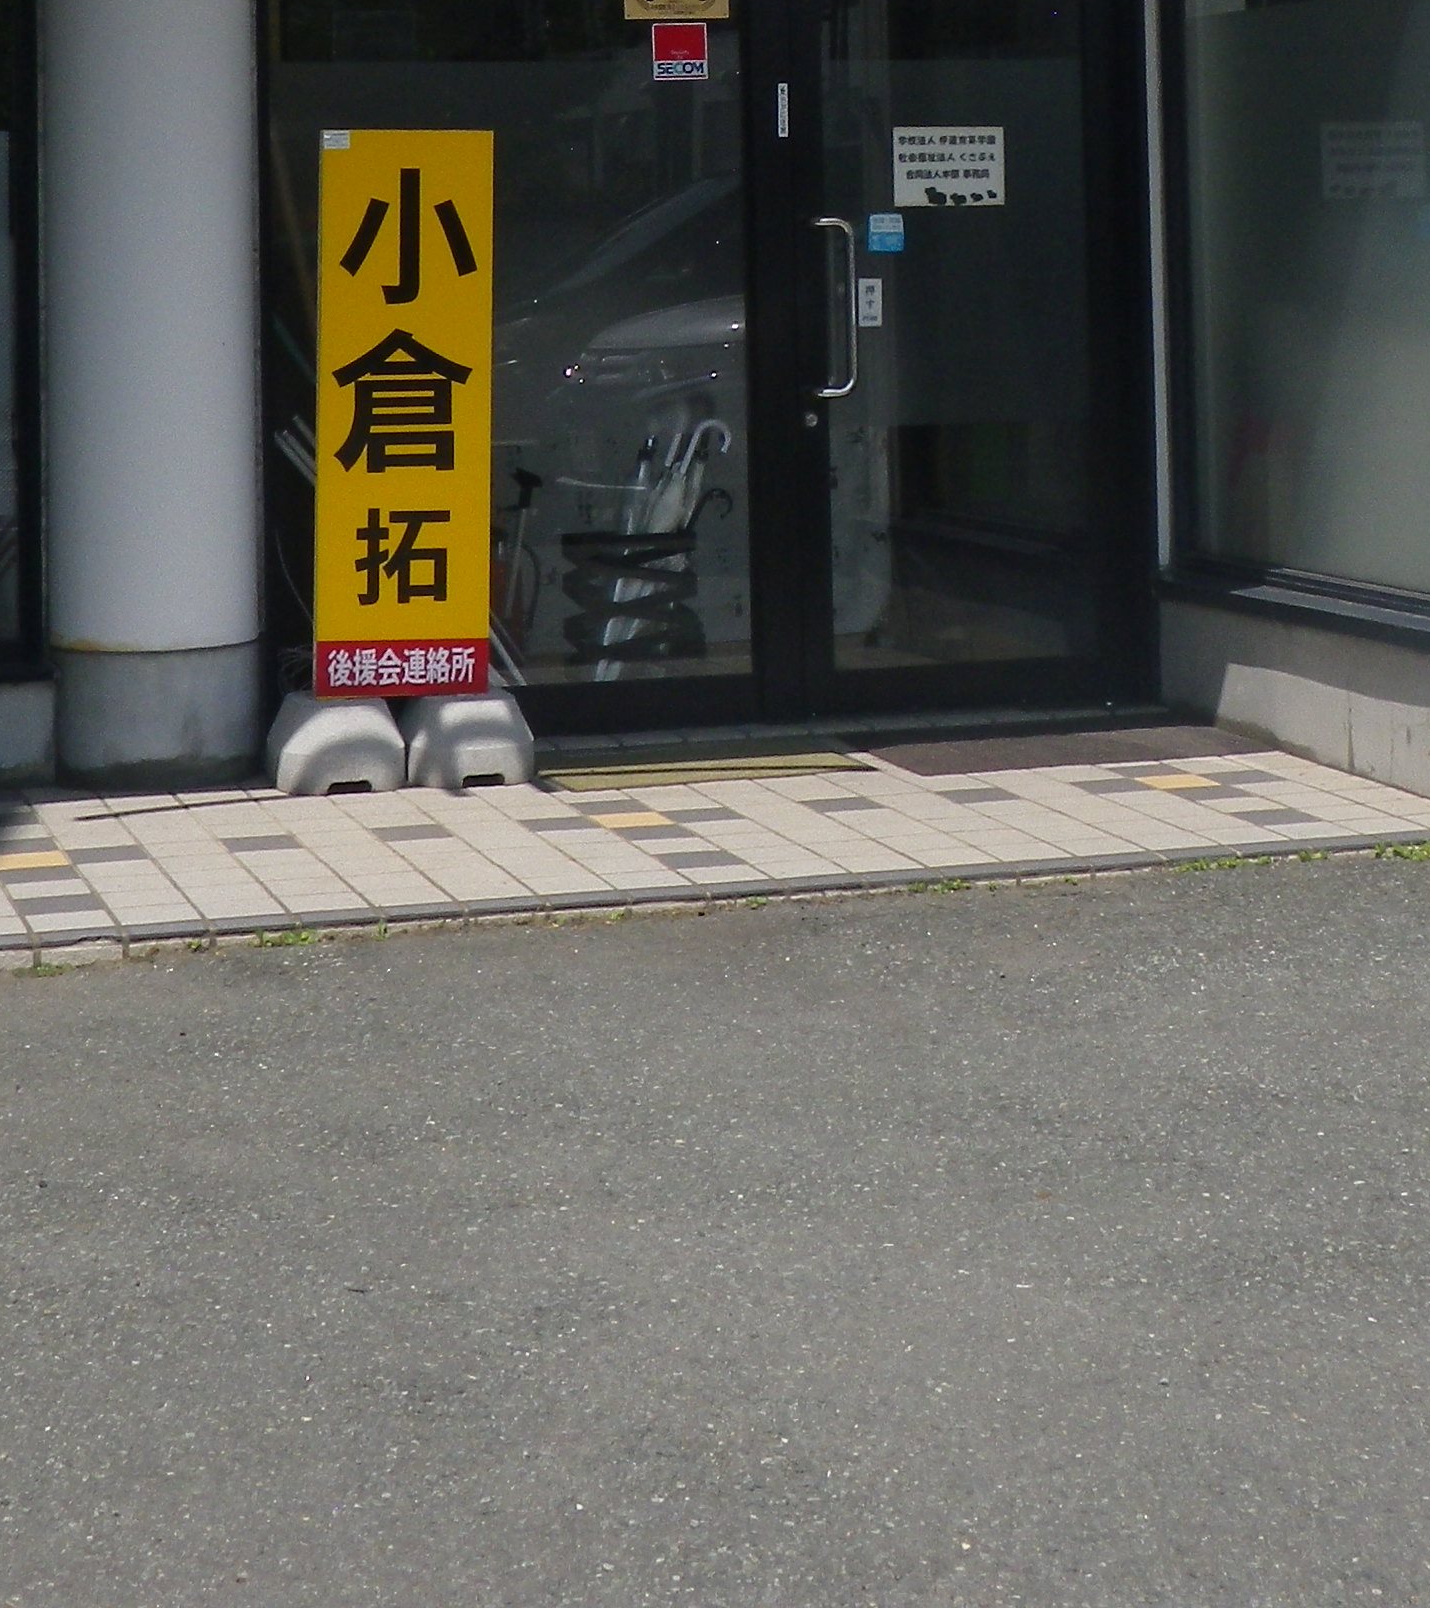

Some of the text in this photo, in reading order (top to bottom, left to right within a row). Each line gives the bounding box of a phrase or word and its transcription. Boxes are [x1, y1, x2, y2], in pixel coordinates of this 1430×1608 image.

[657, 62, 704, 74] SECOM
[331, 168, 478, 606] 小倉拓
[327, 645, 476, 688] 後援会連絡所
